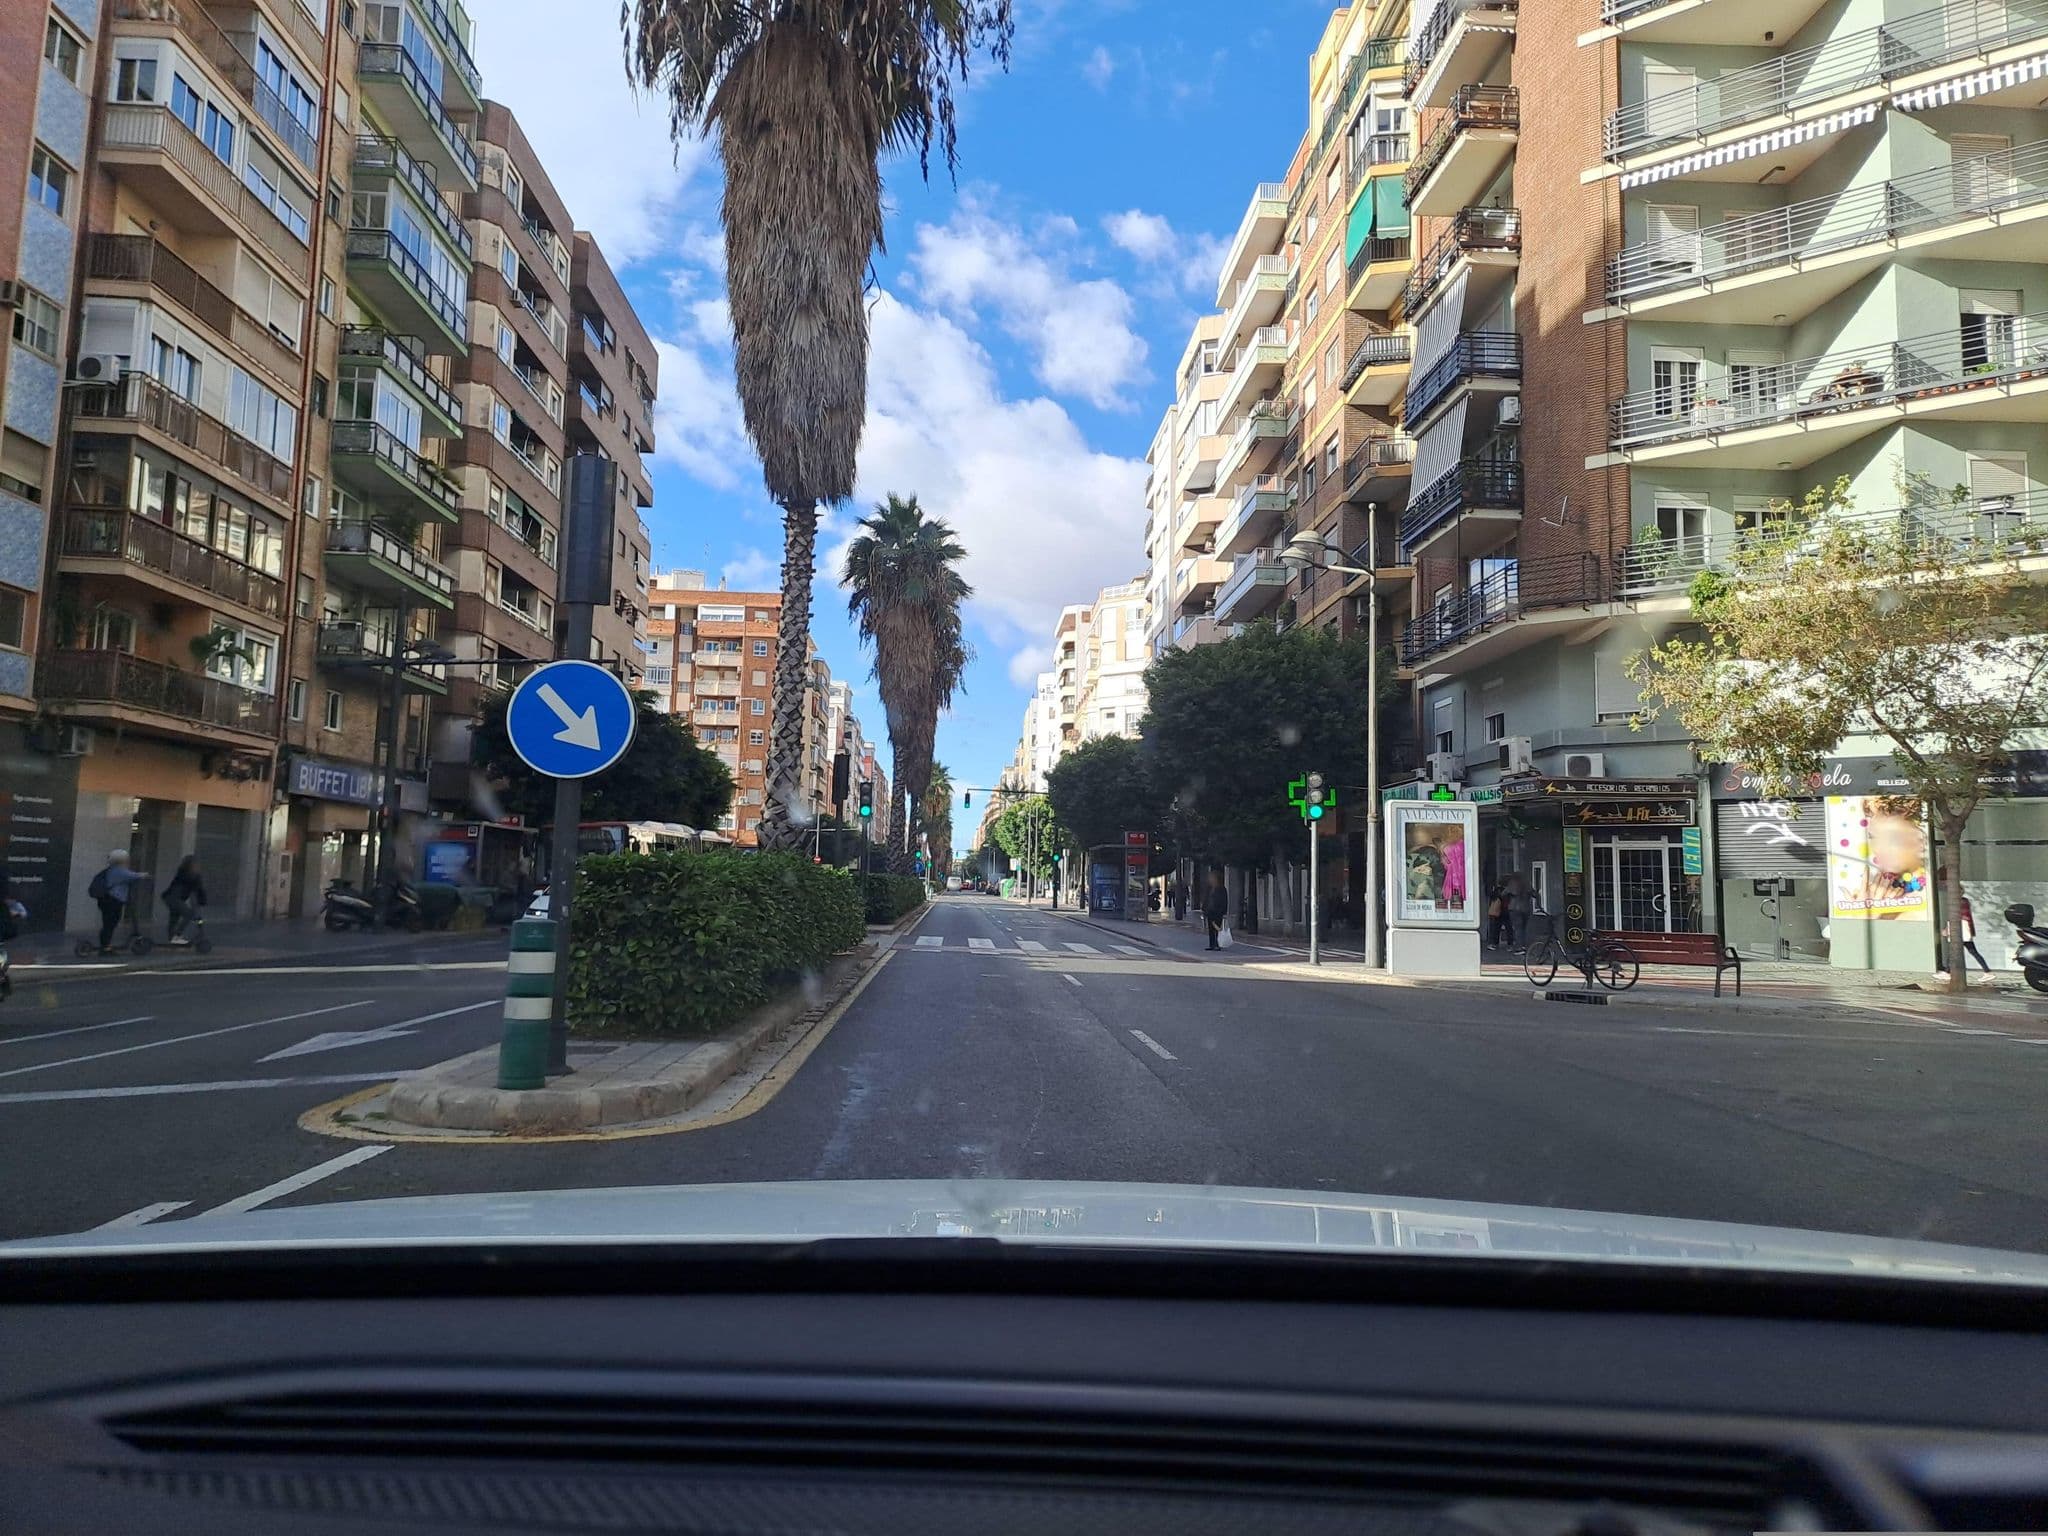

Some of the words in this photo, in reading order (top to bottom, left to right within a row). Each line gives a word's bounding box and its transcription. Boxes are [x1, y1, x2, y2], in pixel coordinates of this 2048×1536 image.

[298, 765, 348, 796] BUFFET
[1586, 783, 1628, 793] ACCESORIOS
[1404, 809, 1465, 820] VALENTINO
[1865, 896, 1922, 909] Perfectas
